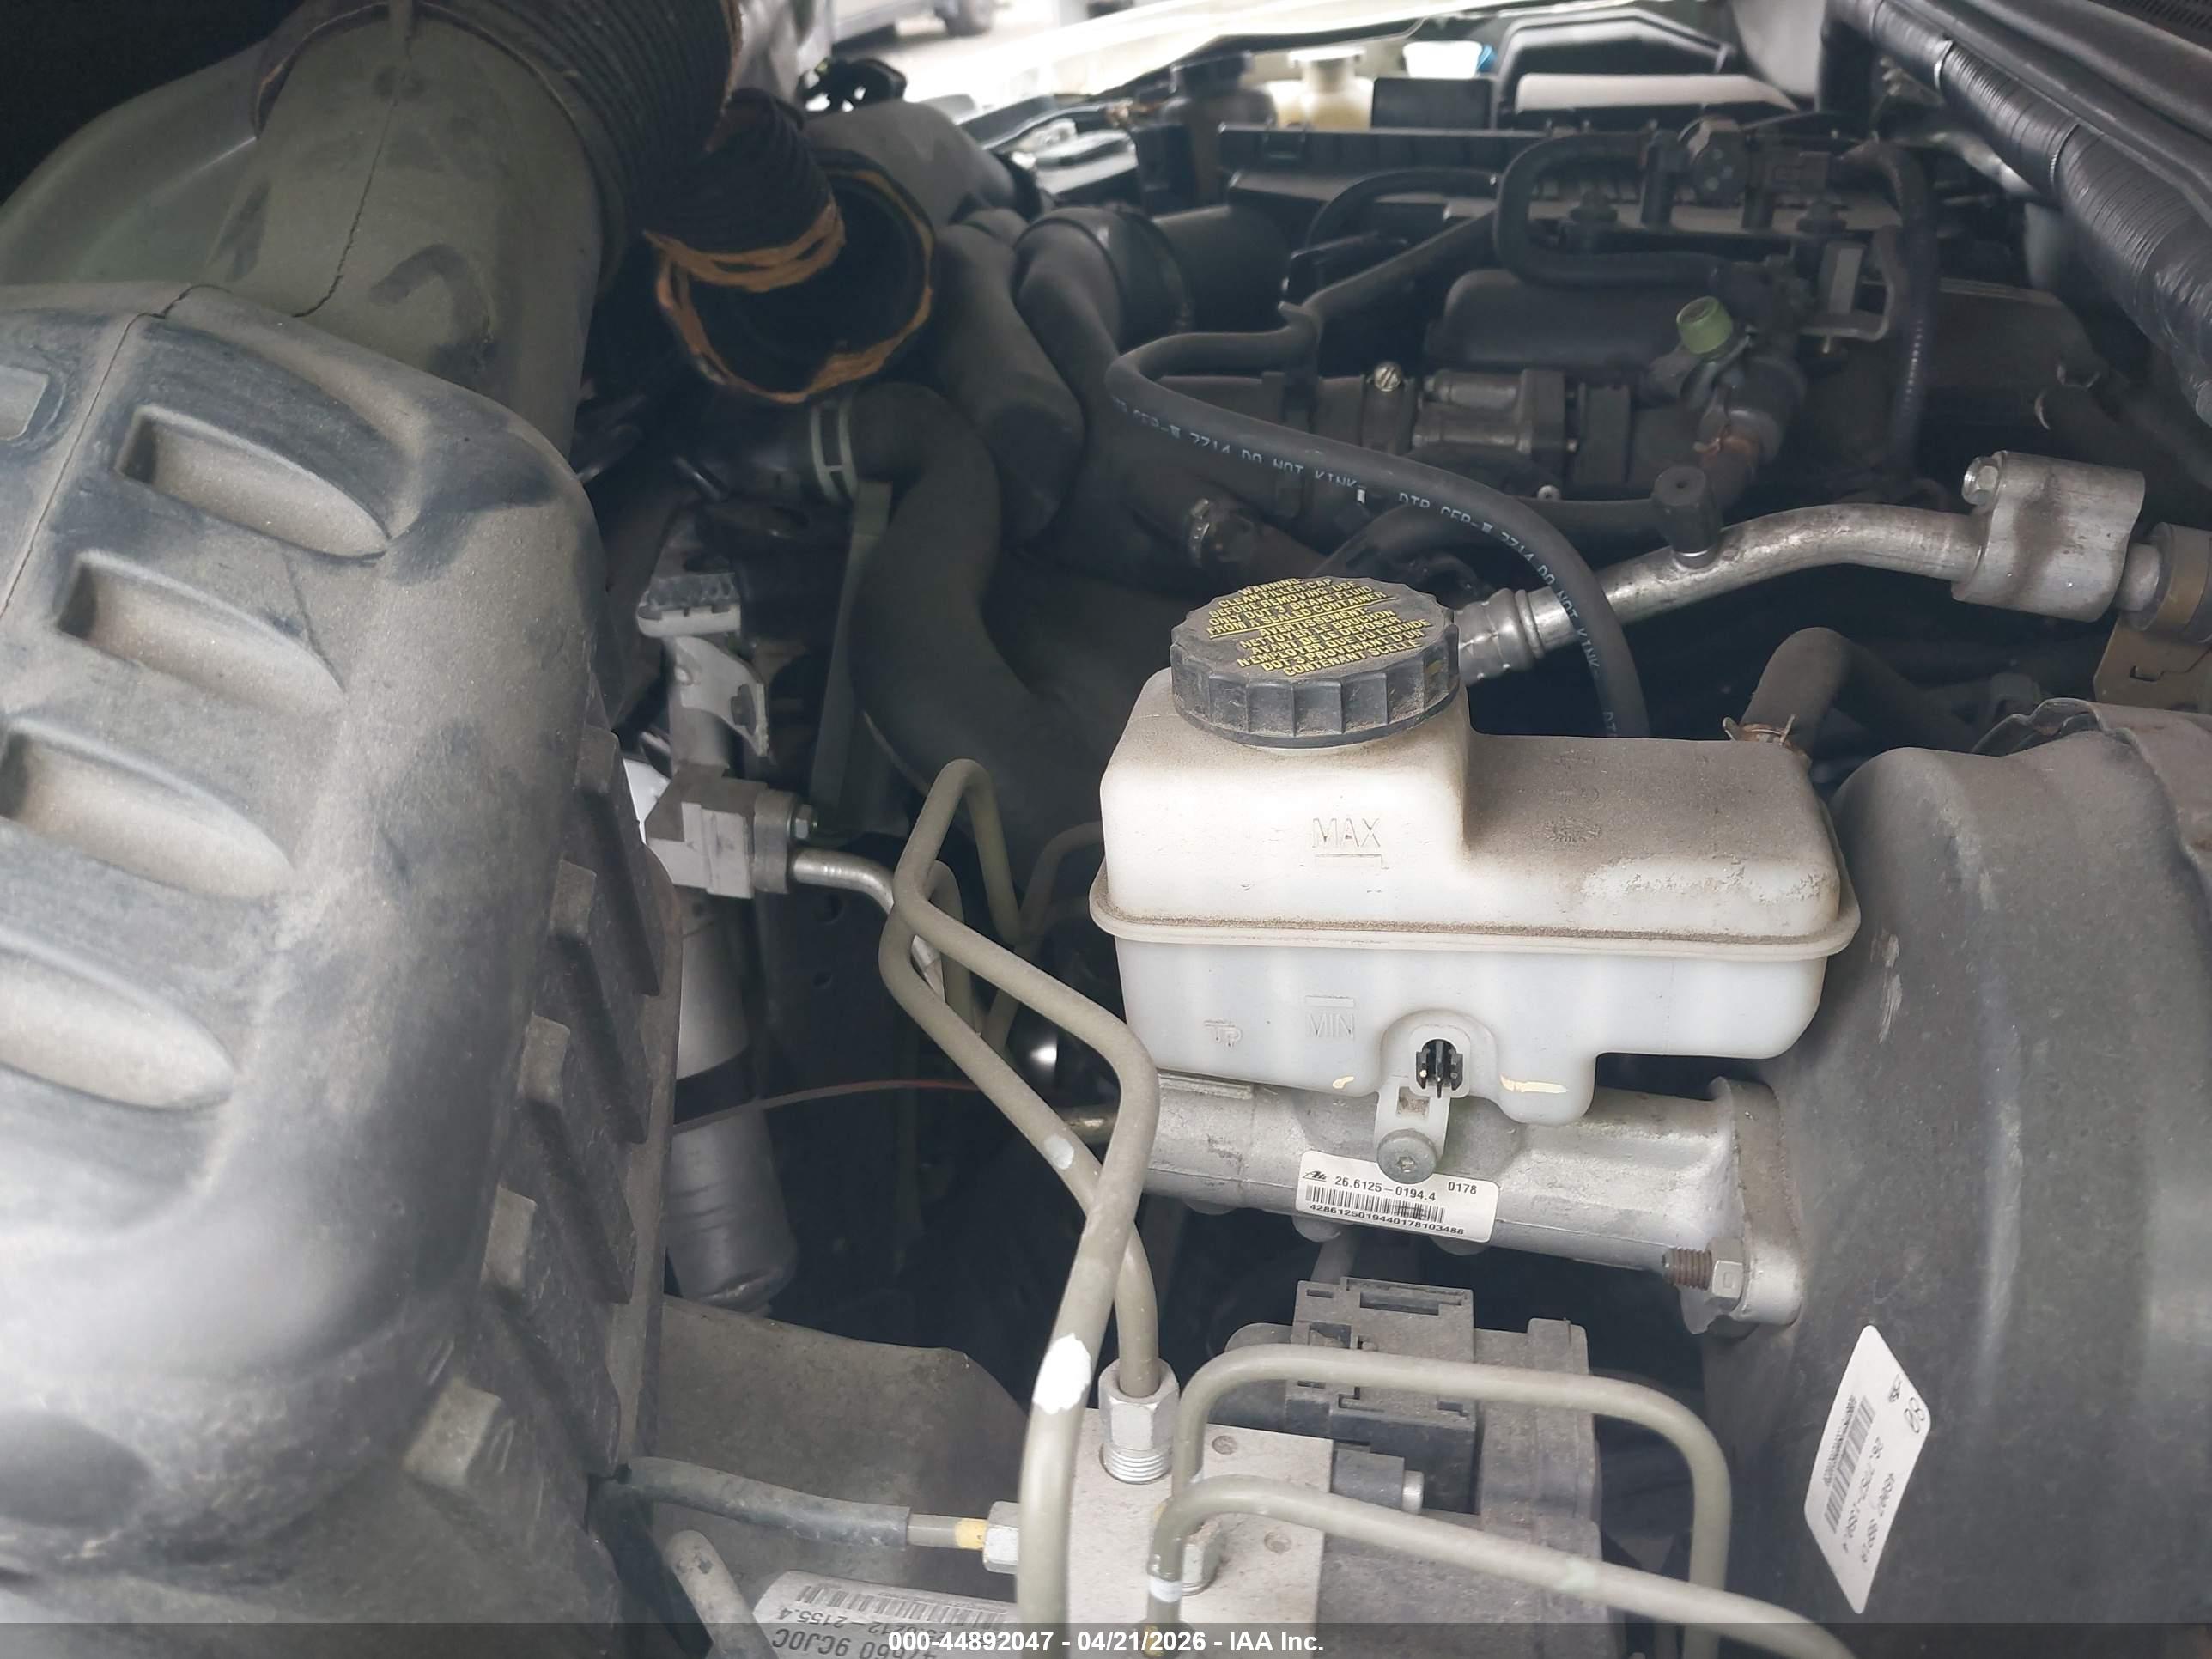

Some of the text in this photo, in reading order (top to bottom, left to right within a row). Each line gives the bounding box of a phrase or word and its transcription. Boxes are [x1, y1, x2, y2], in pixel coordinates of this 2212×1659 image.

[1208, 602, 1260, 618] BEFORE
[1331, 580, 1358, 592] USE
[1208, 586, 1374, 627] ONLY DOT 3 BRAKE FLUID
[1218, 578, 1332, 608] CLEAN FILLER CAP
[1206, 621, 1247, 635] FROM
[1249, 618, 1261, 628] A
[1261, 607, 1312, 625] SEALED
[1240, 609, 1395, 648] NETTOYER LE BOUCHON
[1237, 618, 1431, 667] N'EMPLOYER QUE DU LIQUIDE
[1251, 640, 1297, 655] AVANT
[1299, 635, 1320, 646] DE
[1321, 630, 1339, 641] LE
[1261, 629, 1425, 672] DOT 3 PROVENANT D'UN
[1283, 652, 1367, 677] CONTENANT
[1312, 817, 1382, 848] MAX
[1304, 1012, 1354, 1041] MIN
[1448, 1181, 1477, 1195] 0178
